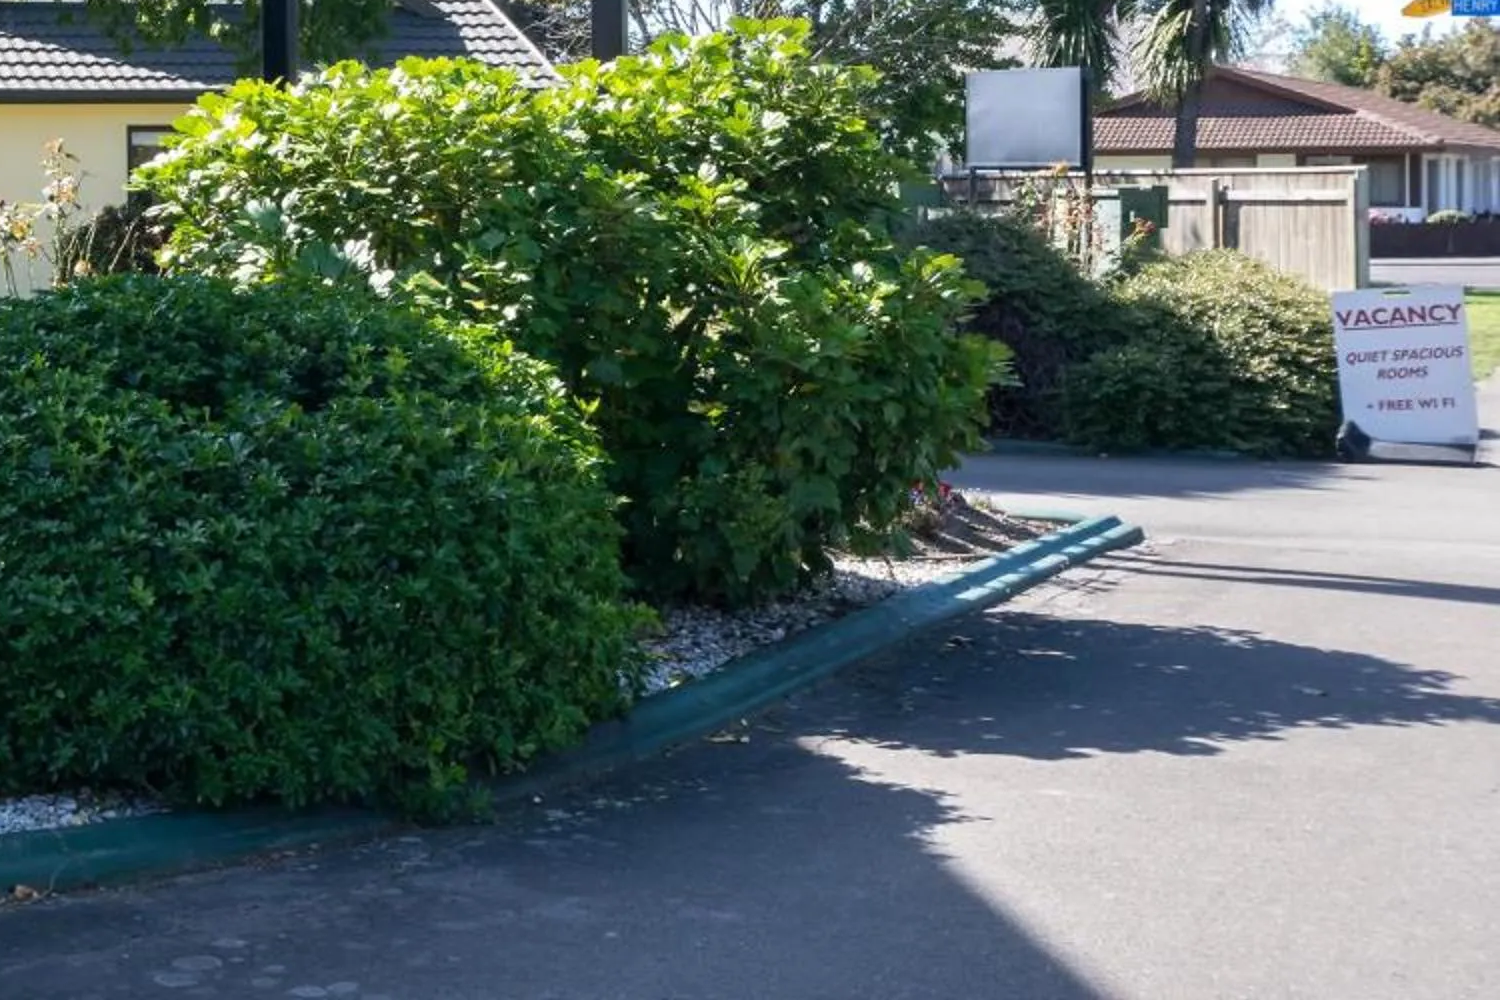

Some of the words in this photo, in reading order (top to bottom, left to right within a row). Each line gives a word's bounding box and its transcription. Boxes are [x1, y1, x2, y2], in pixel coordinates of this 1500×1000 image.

[1336, 303, 1462, 327] VACANCY
[1346, 350, 1387, 366] QUIET
[1391, 346, 1464, 361] SPACIOUS
[1376, 366, 1429, 380] ROOMS
[1378, 399, 1414, 411] FREE
